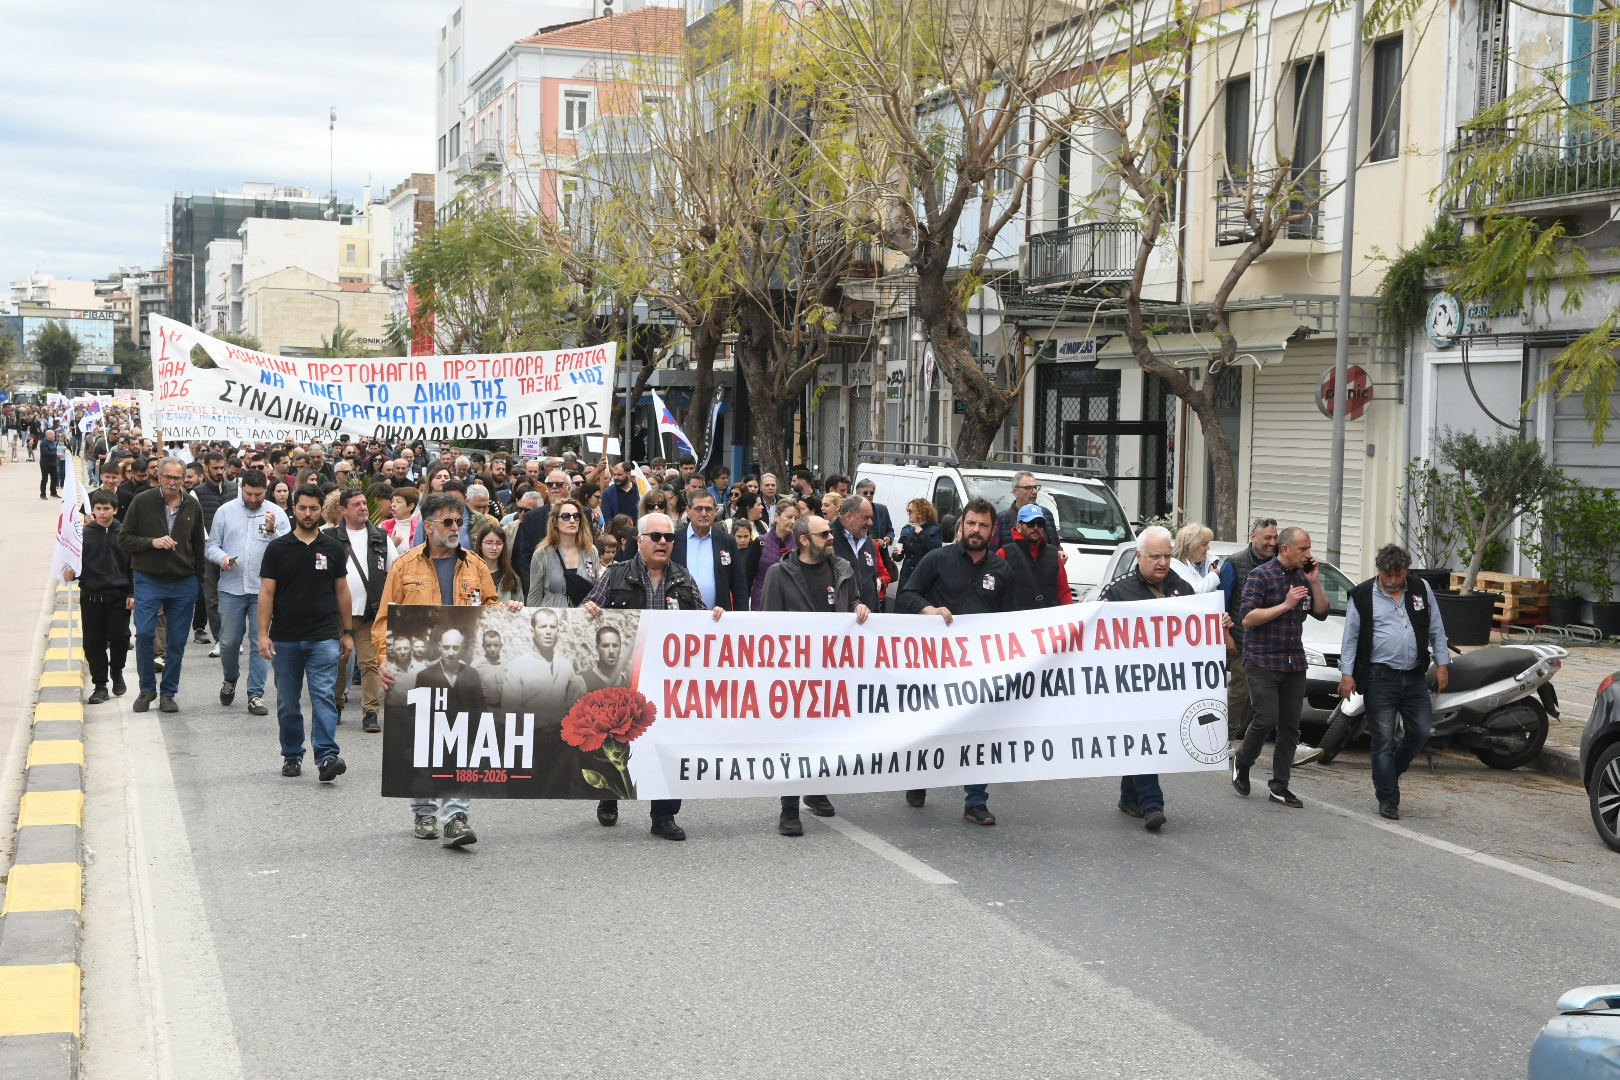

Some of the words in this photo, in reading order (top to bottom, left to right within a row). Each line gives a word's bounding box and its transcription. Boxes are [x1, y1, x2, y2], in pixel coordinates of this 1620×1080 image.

[83, 311, 115, 319] FIBAIR
[307, 361, 427, 384] ΠΡΩΤΟΜΑΓΙΑ
[443, 355, 544, 380] ΠΡΩΤΟΠΟΡΑ
[555, 348, 607, 373] ΕΡΓΑΤΙΑ
[260, 369, 286, 389] ΝΑ
[299, 379, 343, 402] ΓΙΝΕΙ
[365, 383, 389, 404] ΤΟ
[413, 381, 461, 404] ΔΙΚΙΟ
[470, 378, 508, 400] ΤΗΣ
[518, 374, 563, 396] ΤΑΞΗΣ
[569, 365, 605, 386] ΜΑΣ
[219, 380, 343, 432] ΣΥΝΔΙΚΑΤΟ
[329, 401, 508, 425] ΠΡΑΓΜΑΤΙΚΟΤΗΤΑ
[518, 401, 602, 437] ΠΑΤΡΑΣ
[662, 633, 811, 668] ΟΡΓΑΝΩΣΗ
[822, 635, 865, 668] ΚΑΙ
[875, 636, 973, 668] ΑΓΩΝΑΣ
[979, 632, 1026, 664] ΓΙΑ
[1031, 620, 1085, 655] ΤΗΝ
[663, 679, 760, 719] ΚΑΜΙΑ
[768, 679, 851, 718] ΘΥΣΙΑ
[857, 684, 889, 713] ΓΙΑ
[896, 683, 940, 712] ΤΟΝ
[943, 671, 1036, 707] ΠΟΛΕΜΟ
[1040, 667, 1076, 697] ΚΑΙ
[1080, 665, 1110, 695] ΤΑ
[1114, 661, 1187, 694] ΚΕΡΔΗ
[432, 711, 535, 769] ΜΑΗ
[959, 738, 1054, 767] ΚΕΝΤΡΟ
[1071, 732, 1168, 760] ΠΑΤΡΑΣ
[456, 770, 508, 783] 1886-2026
